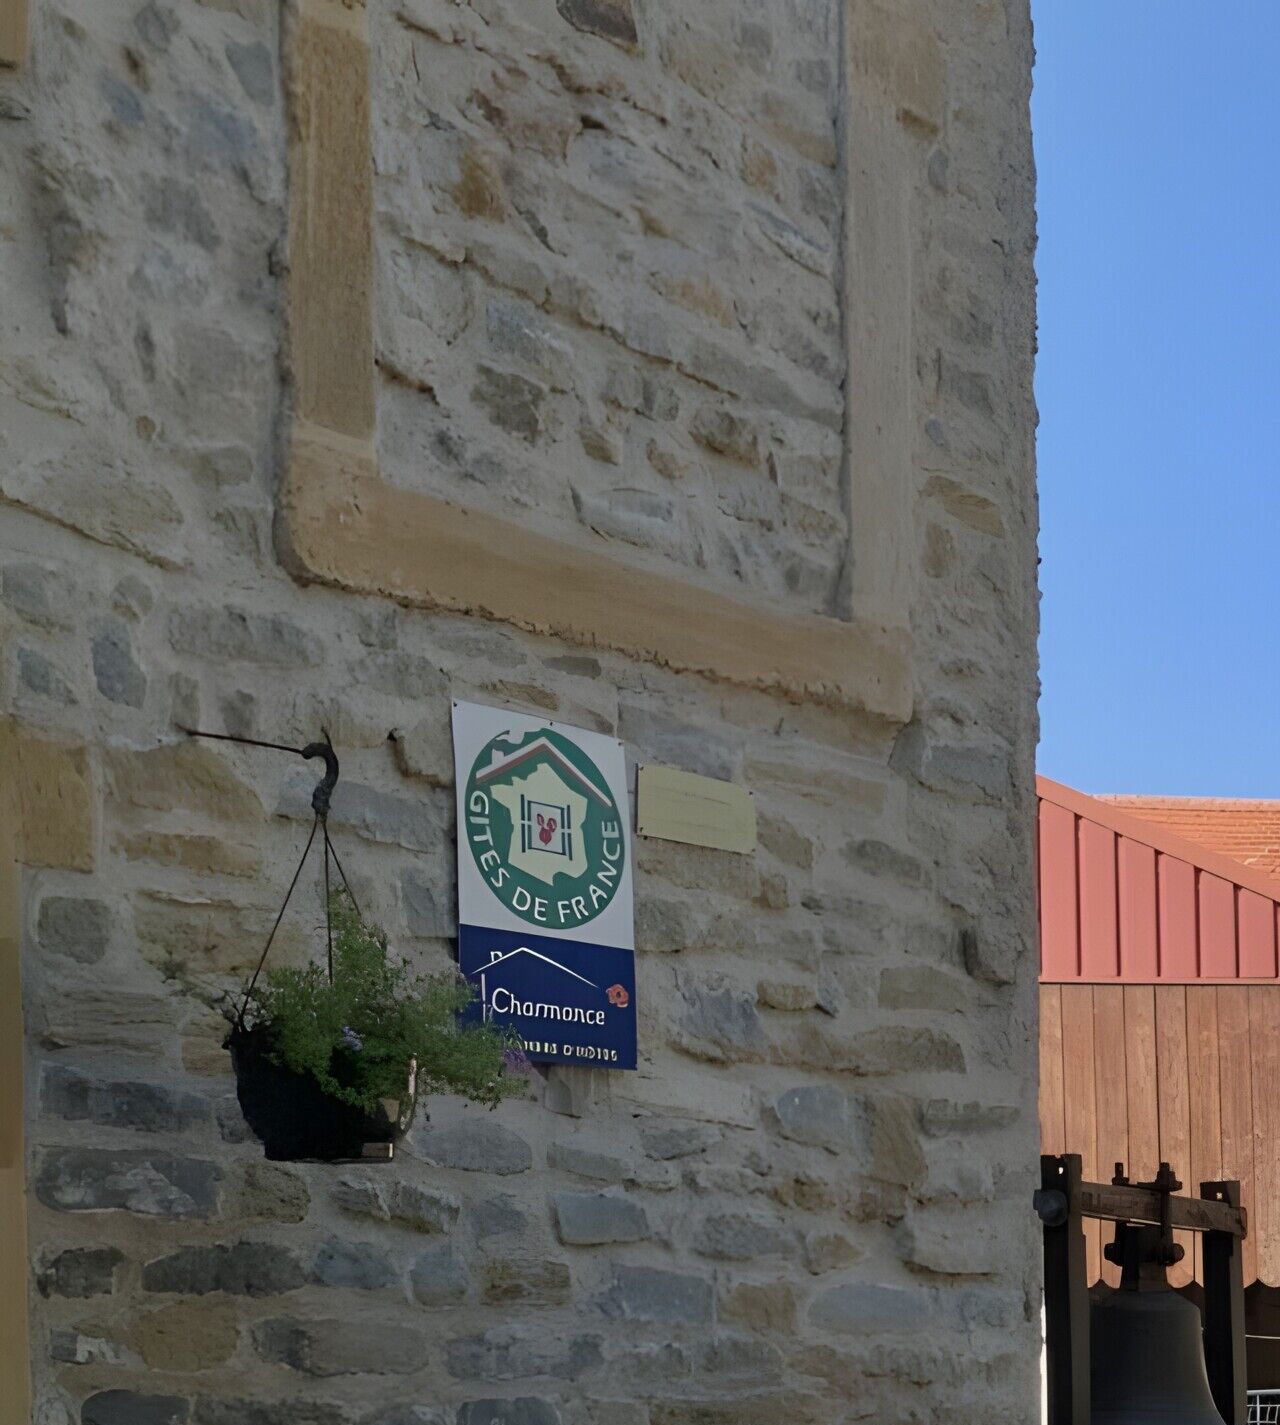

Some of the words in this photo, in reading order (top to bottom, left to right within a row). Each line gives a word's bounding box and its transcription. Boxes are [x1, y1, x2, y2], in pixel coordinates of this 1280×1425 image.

[469, 790, 511, 888] GITES
[512, 886, 549, 922] DE
[557, 820, 621, 923] FRANCE
